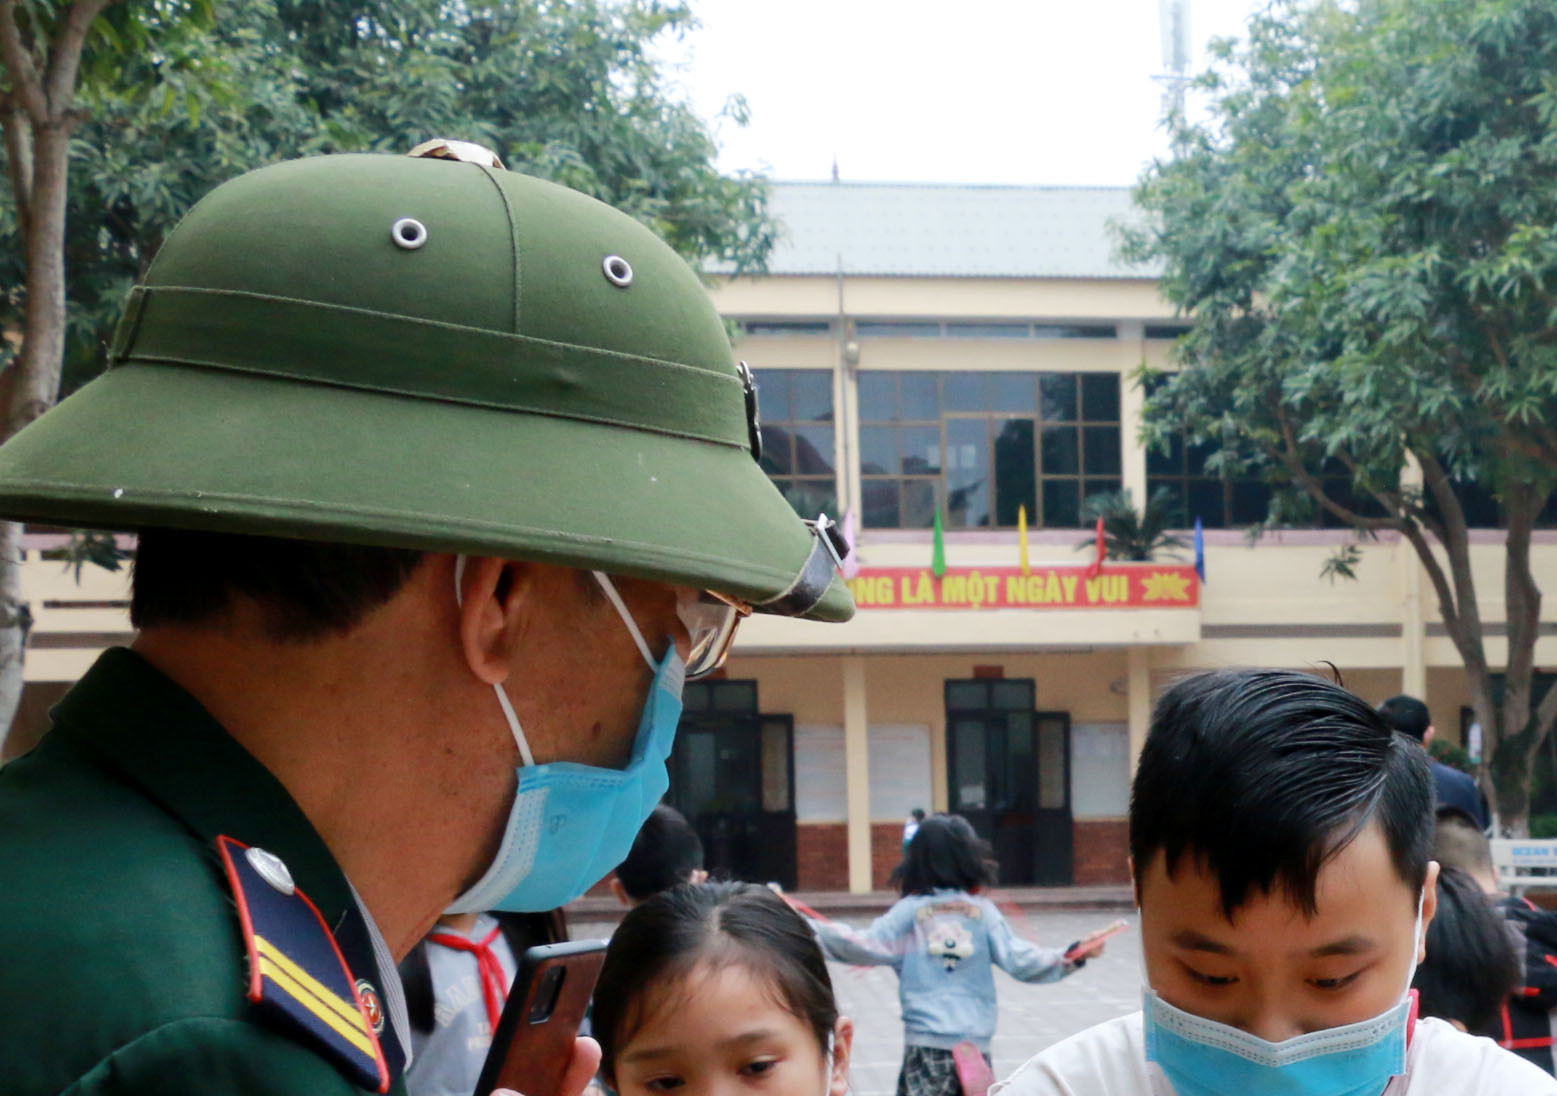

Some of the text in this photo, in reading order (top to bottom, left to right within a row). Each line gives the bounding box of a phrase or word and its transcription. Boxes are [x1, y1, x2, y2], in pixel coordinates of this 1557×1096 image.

[901, 570, 935, 604] LÀ
[941, 570, 999, 609] MỘT
[1006, 570, 1078, 604] NGÀY
[1085, 575, 1129, 604] VUI
